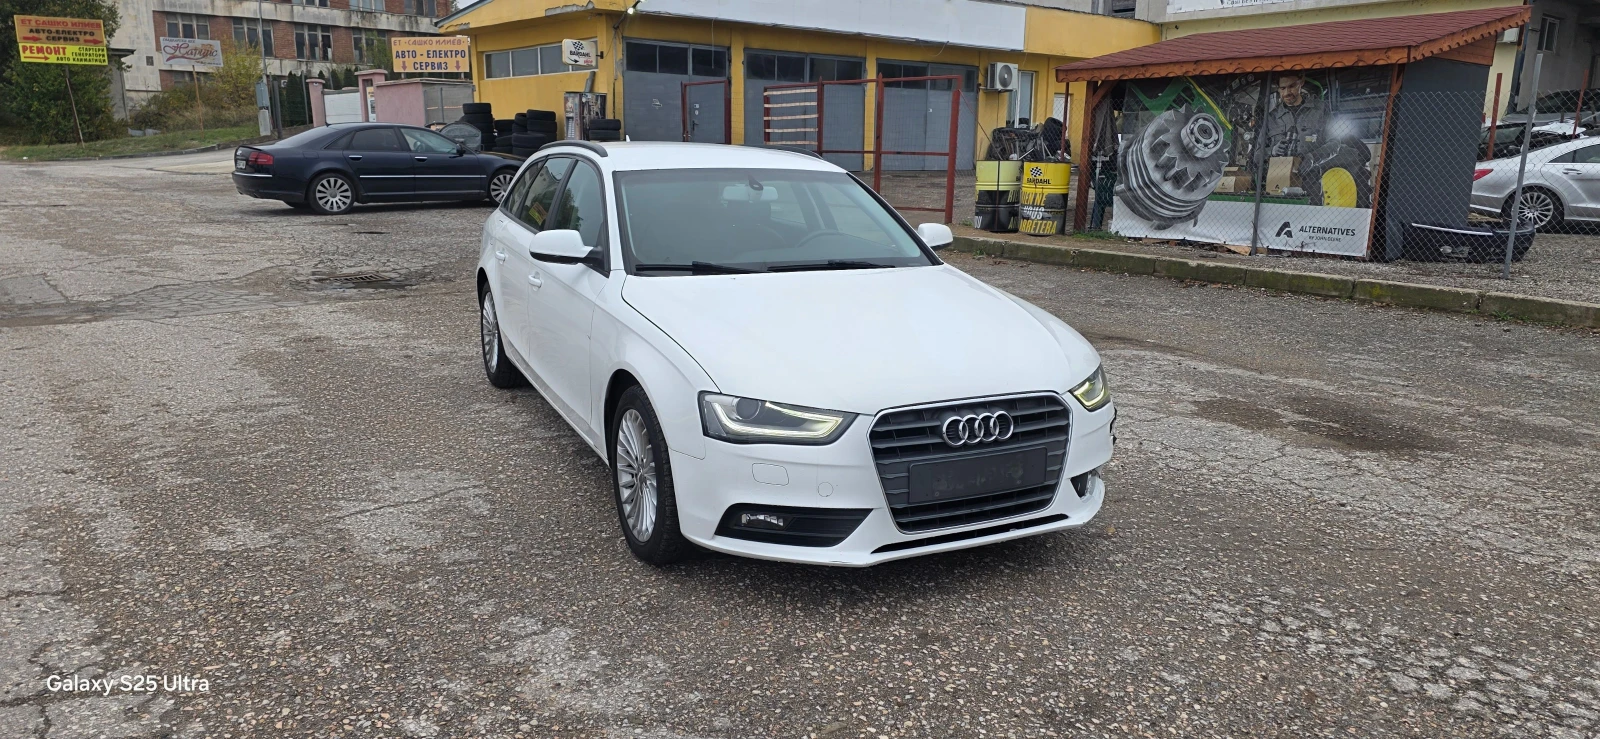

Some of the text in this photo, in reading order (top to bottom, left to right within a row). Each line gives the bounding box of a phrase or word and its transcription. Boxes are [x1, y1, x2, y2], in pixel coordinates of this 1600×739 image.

[29, 28, 95, 36] АВТО-ЕЛЕКТРО
[21, 45, 67, 56] РЕМОНТ
[395, 50, 417, 59] АВТО
[426, 50, 466, 58] ЕЛЕКТРО
[413, 61, 448, 70] СЕРВИЗ
[1299, 226, 1356, 236] ALTERNATIVES
